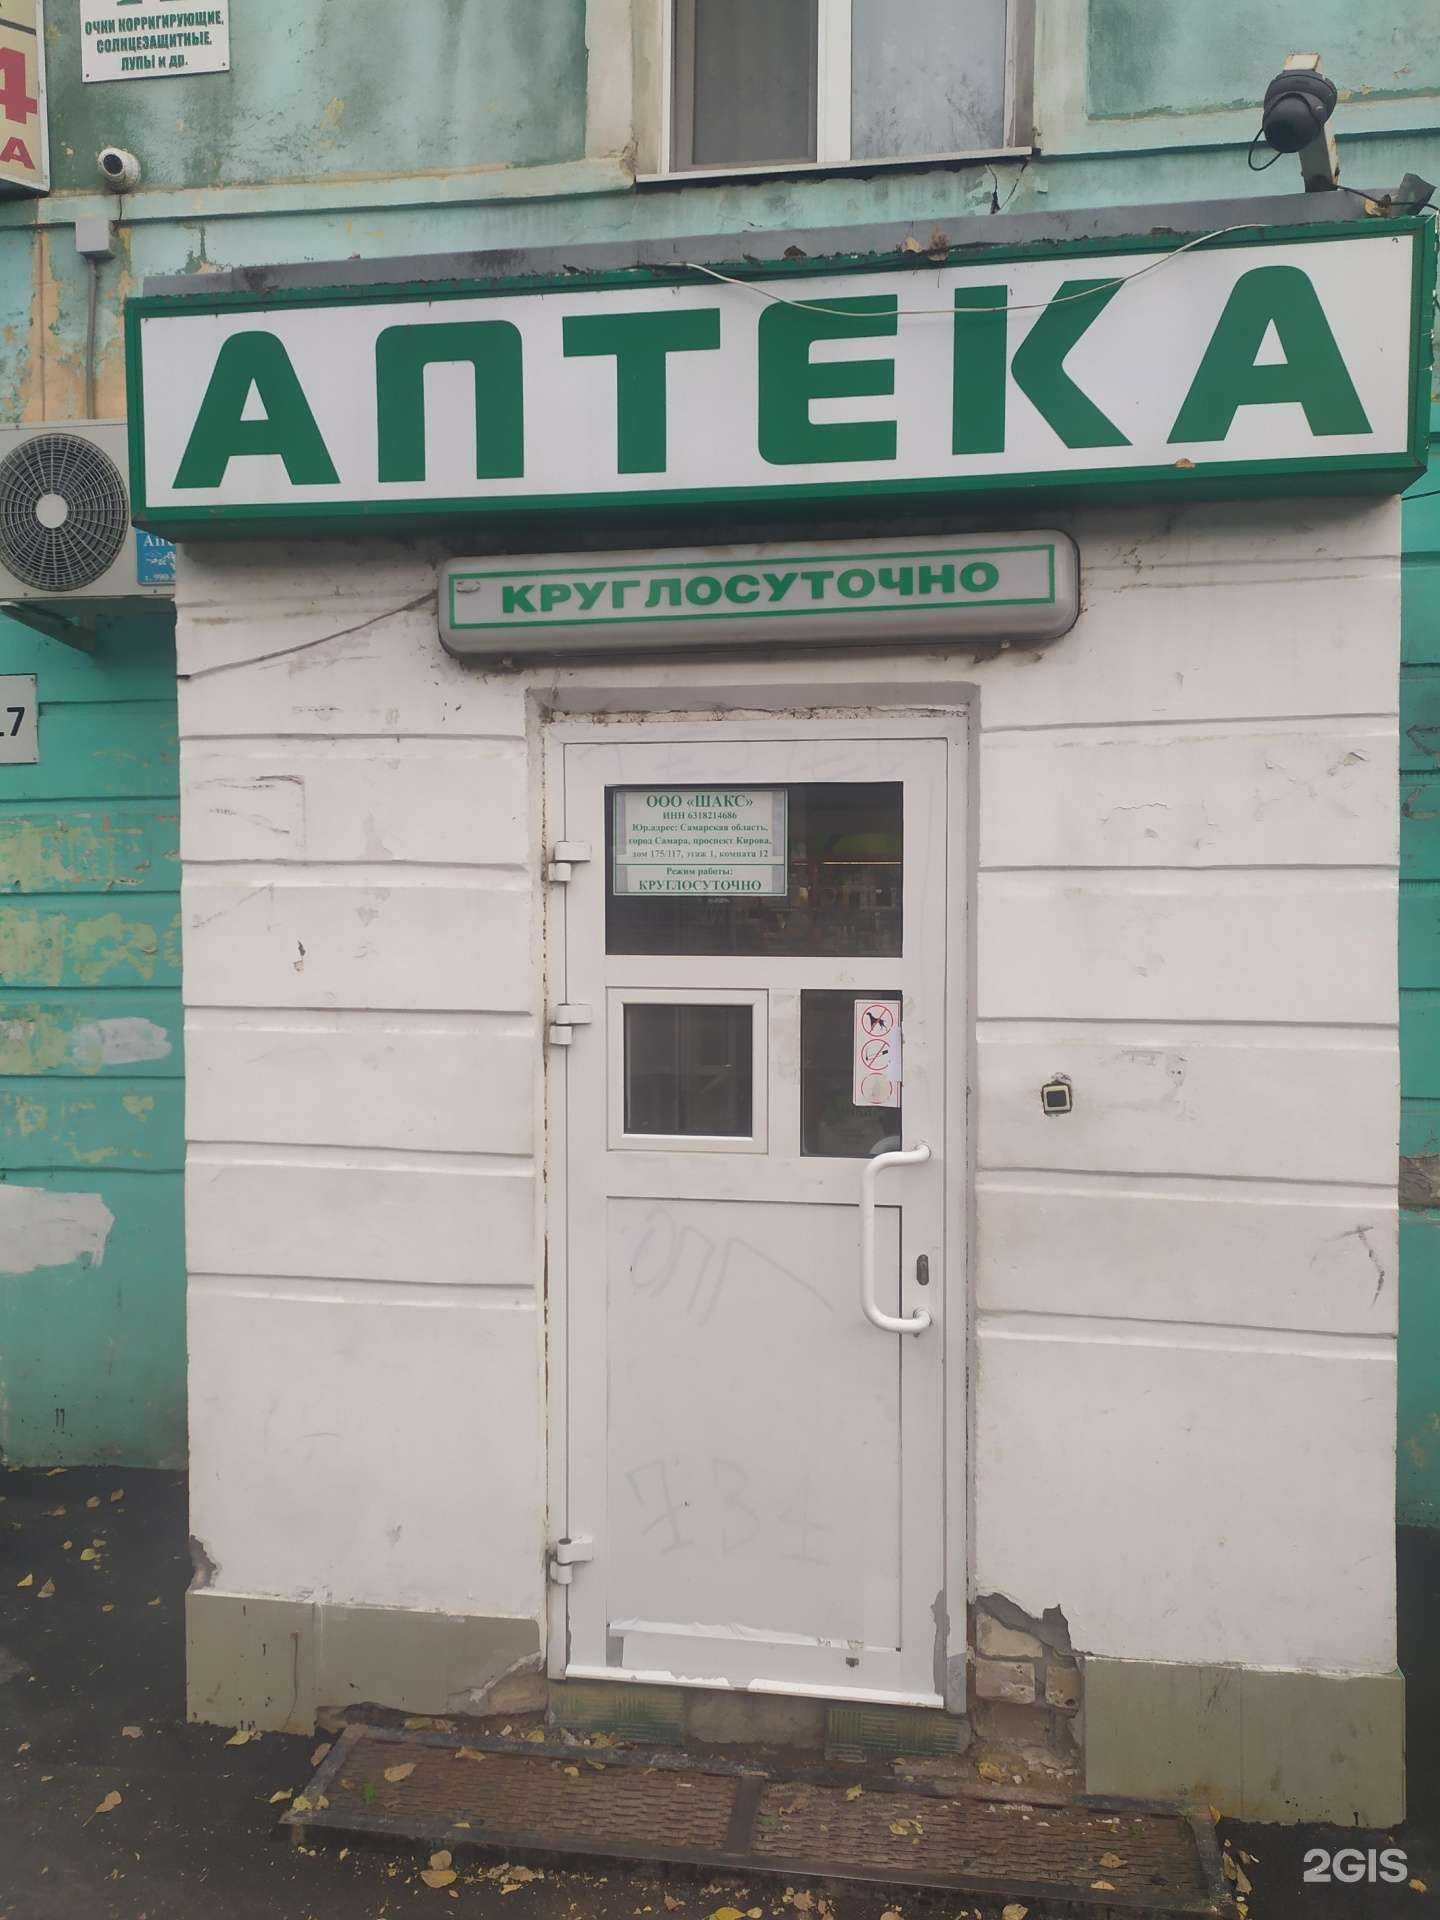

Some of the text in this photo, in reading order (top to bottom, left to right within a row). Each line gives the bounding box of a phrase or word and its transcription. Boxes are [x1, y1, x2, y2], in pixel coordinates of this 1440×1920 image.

[84, 10, 225, 35] ОЧКИ КОРРИГИРУЮЩИЕ,
[96, 31, 213, 54] СОЛНЦЕЗАЩИТНЫЕ,
[121, 54, 156, 71] ЛУПЫ
[172, 264, 1374, 490] АПТЕКА
[502, 561, 1000, 614] КРУГЛОСУТОЧНО
[0, 706, 25, 737] 7
[646, 794, 753, 808] ООО «ШАКС»
[663, 811, 738, 820] ИНН 6318214686
[680, 823, 729, 833] Самарская
[731, 823, 769, 832] область,
[628, 837, 653, 846] город
[654, 836, 691, 846] Самара,
[693, 837, 733, 846] проспект
[632, 850, 648, 858] дом
[719, 850, 757, 858] комната
[759, 849, 769, 858] 12
[666, 867, 733, 877] Режим работы:
[639, 879, 762, 891] КРУГЛОСУТОЧНО
